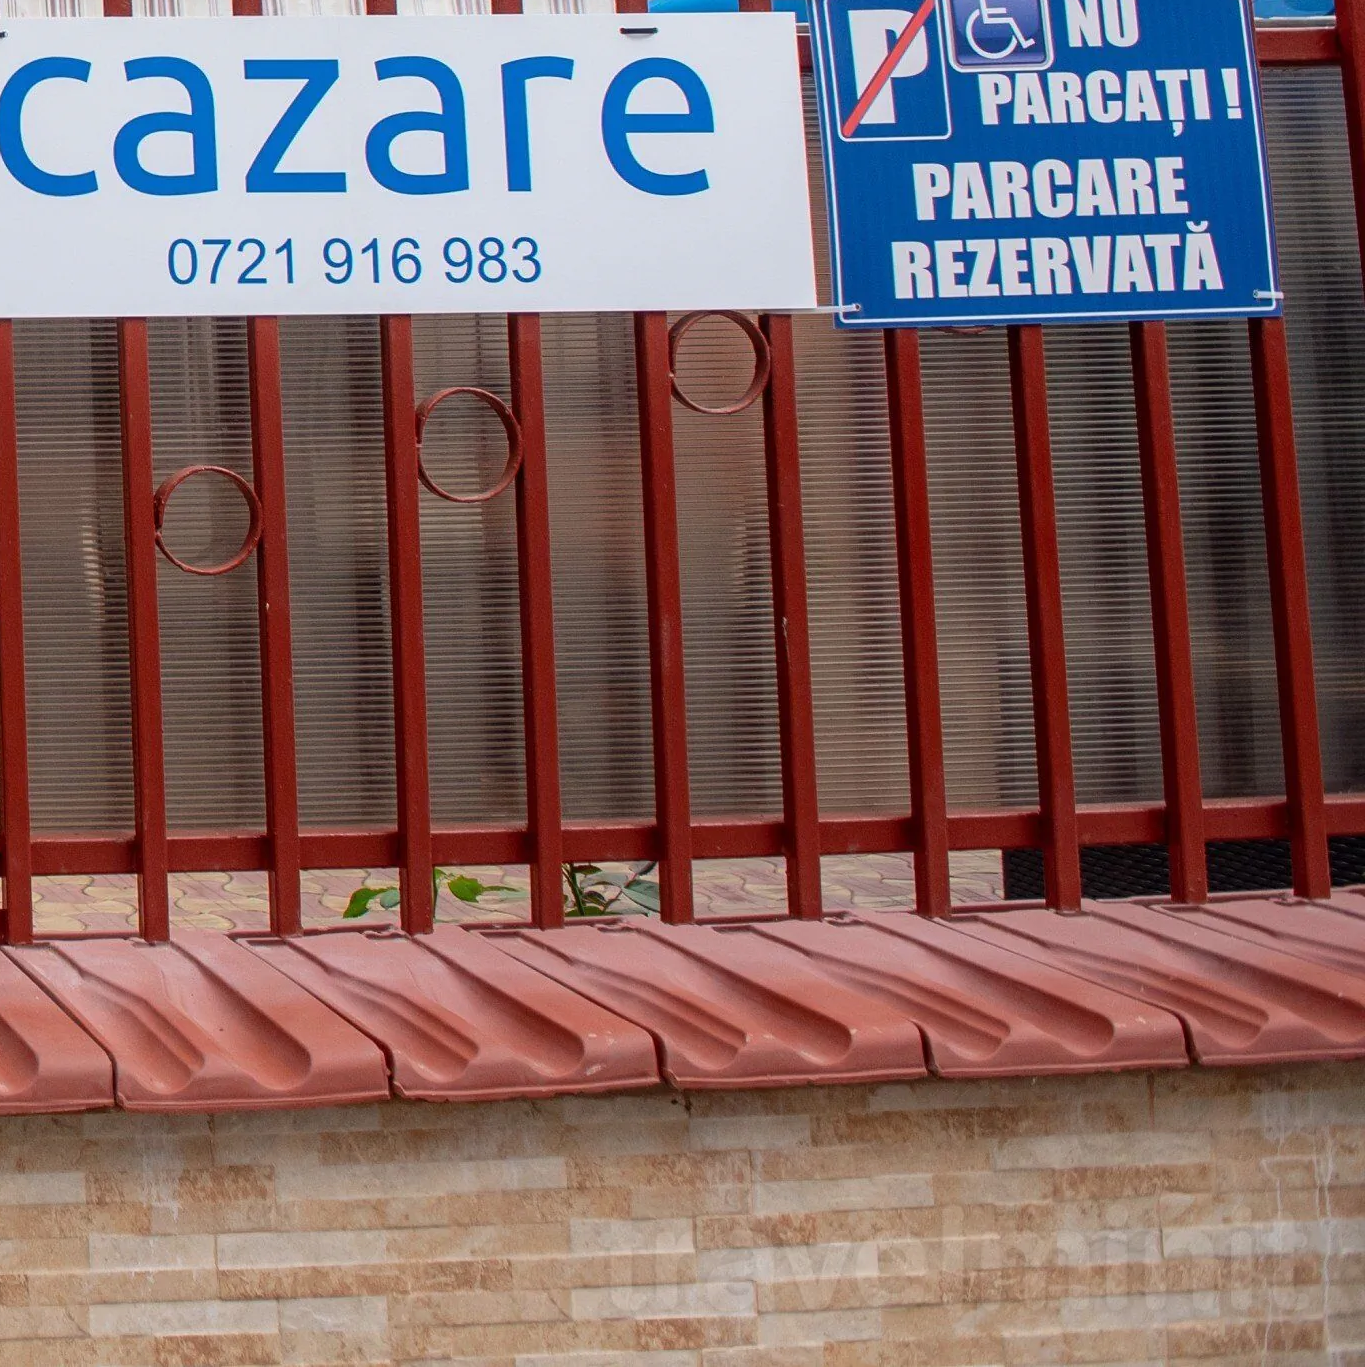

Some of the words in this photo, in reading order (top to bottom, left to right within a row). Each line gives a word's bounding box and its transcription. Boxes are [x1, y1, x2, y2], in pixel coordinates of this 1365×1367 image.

[911, 157, 1189, 222] PARCARE
[168, 236, 297, 286] 0721
[323, 236, 424, 286] 916
[443, 235, 543, 285] 983
[891, 220, 1224, 299] REZERVATĂ
